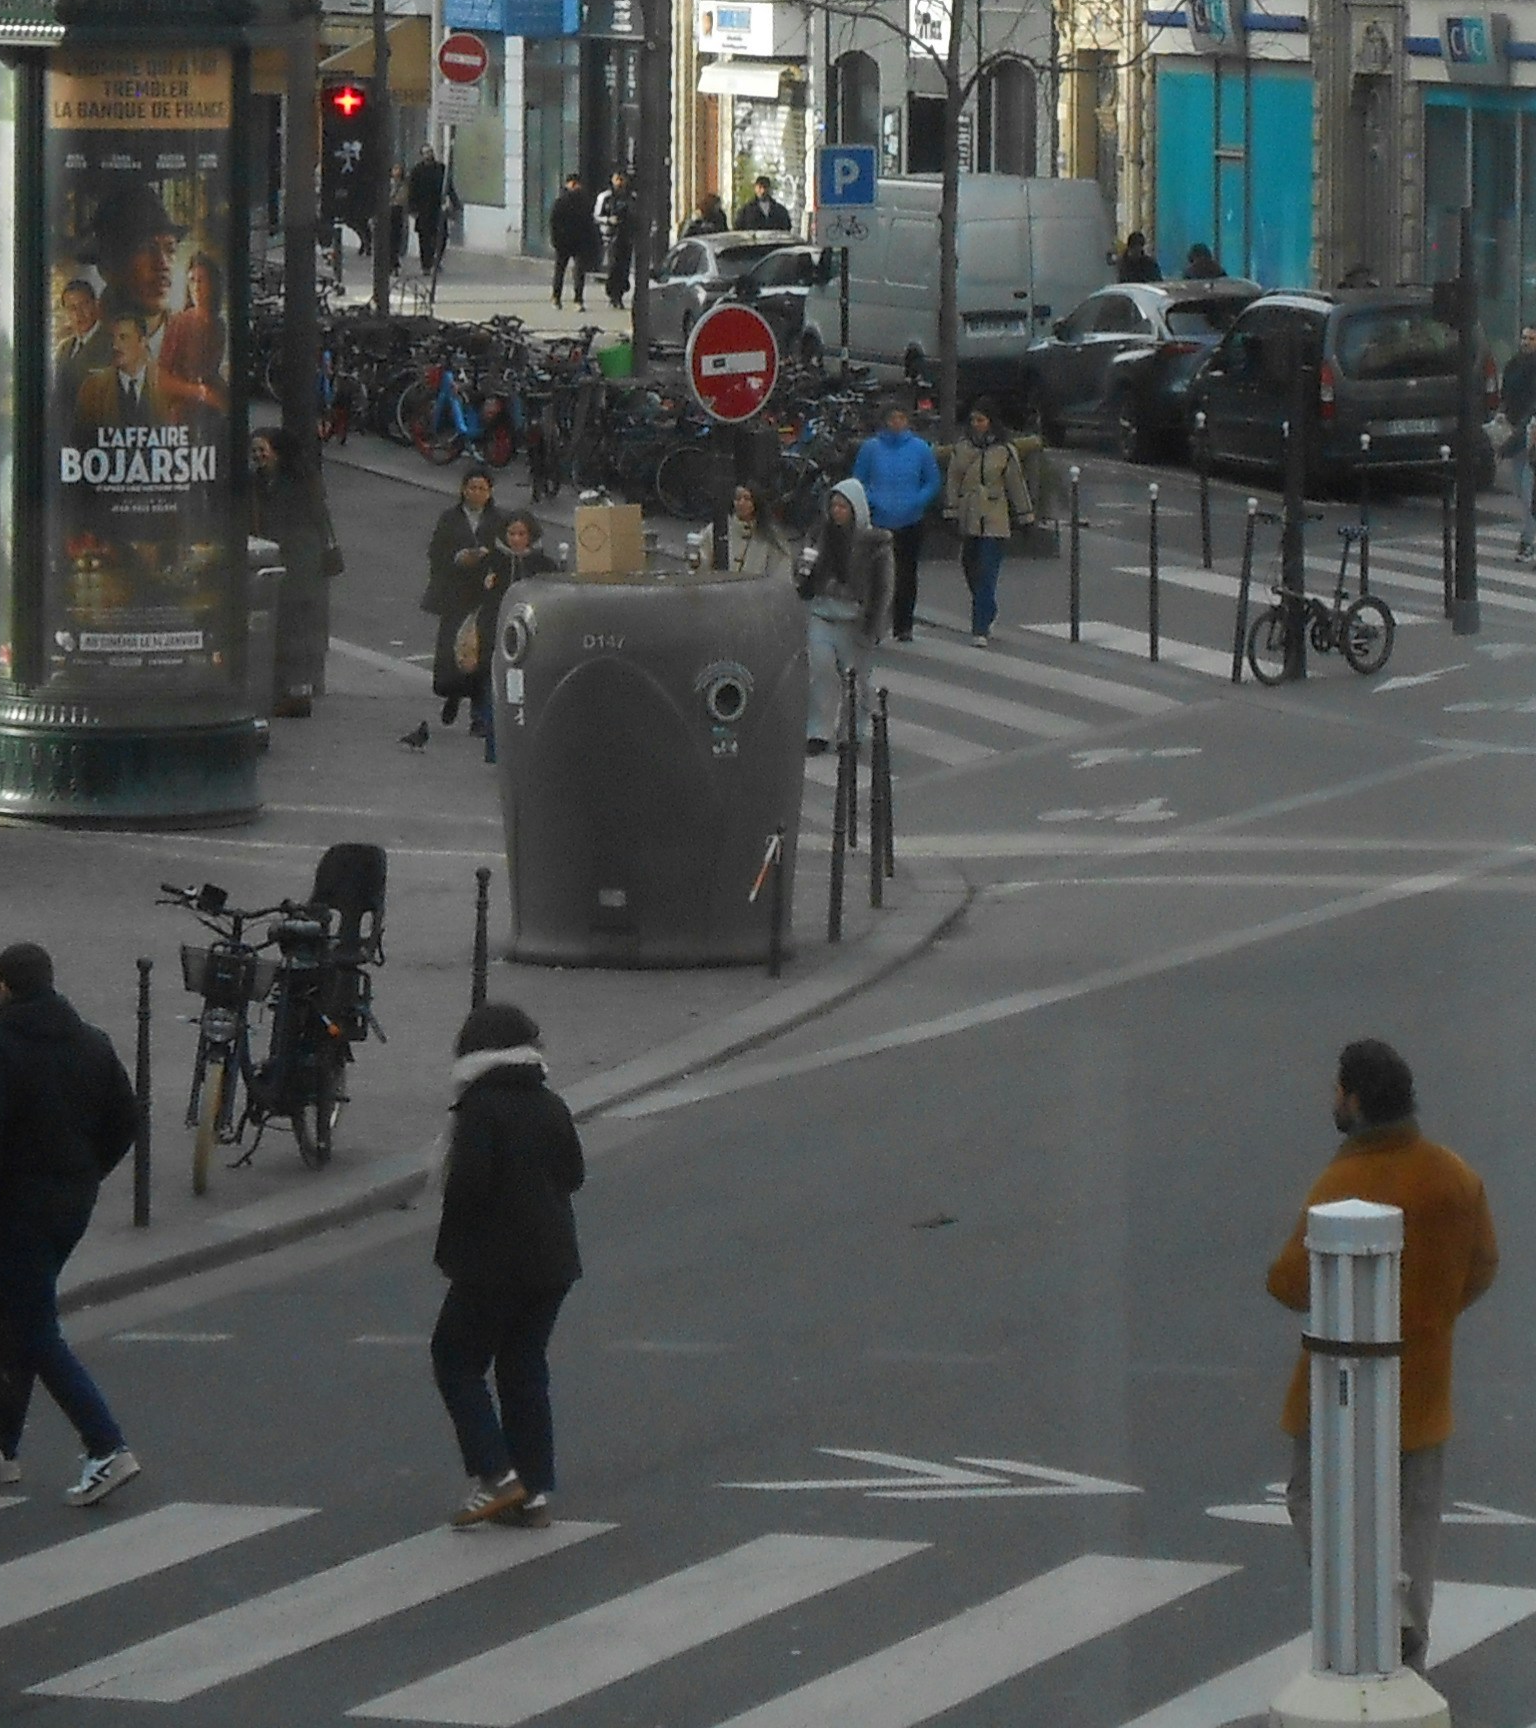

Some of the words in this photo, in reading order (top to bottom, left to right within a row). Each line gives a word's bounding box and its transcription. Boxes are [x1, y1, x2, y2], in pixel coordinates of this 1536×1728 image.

[1450, 27, 1483, 57] CIC
[103, 80, 188, 97] TREMBLER
[55, 103, 71, 118] LA
[77, 101, 146, 120] BANQUE
[152, 102, 171, 118] DE
[176, 101, 224, 118] FRANCE
[834, 158, 859, 194] P
[98, 425, 189, 447] L'AFFAIRE
[61, 445, 216, 483] BOJARSKI
